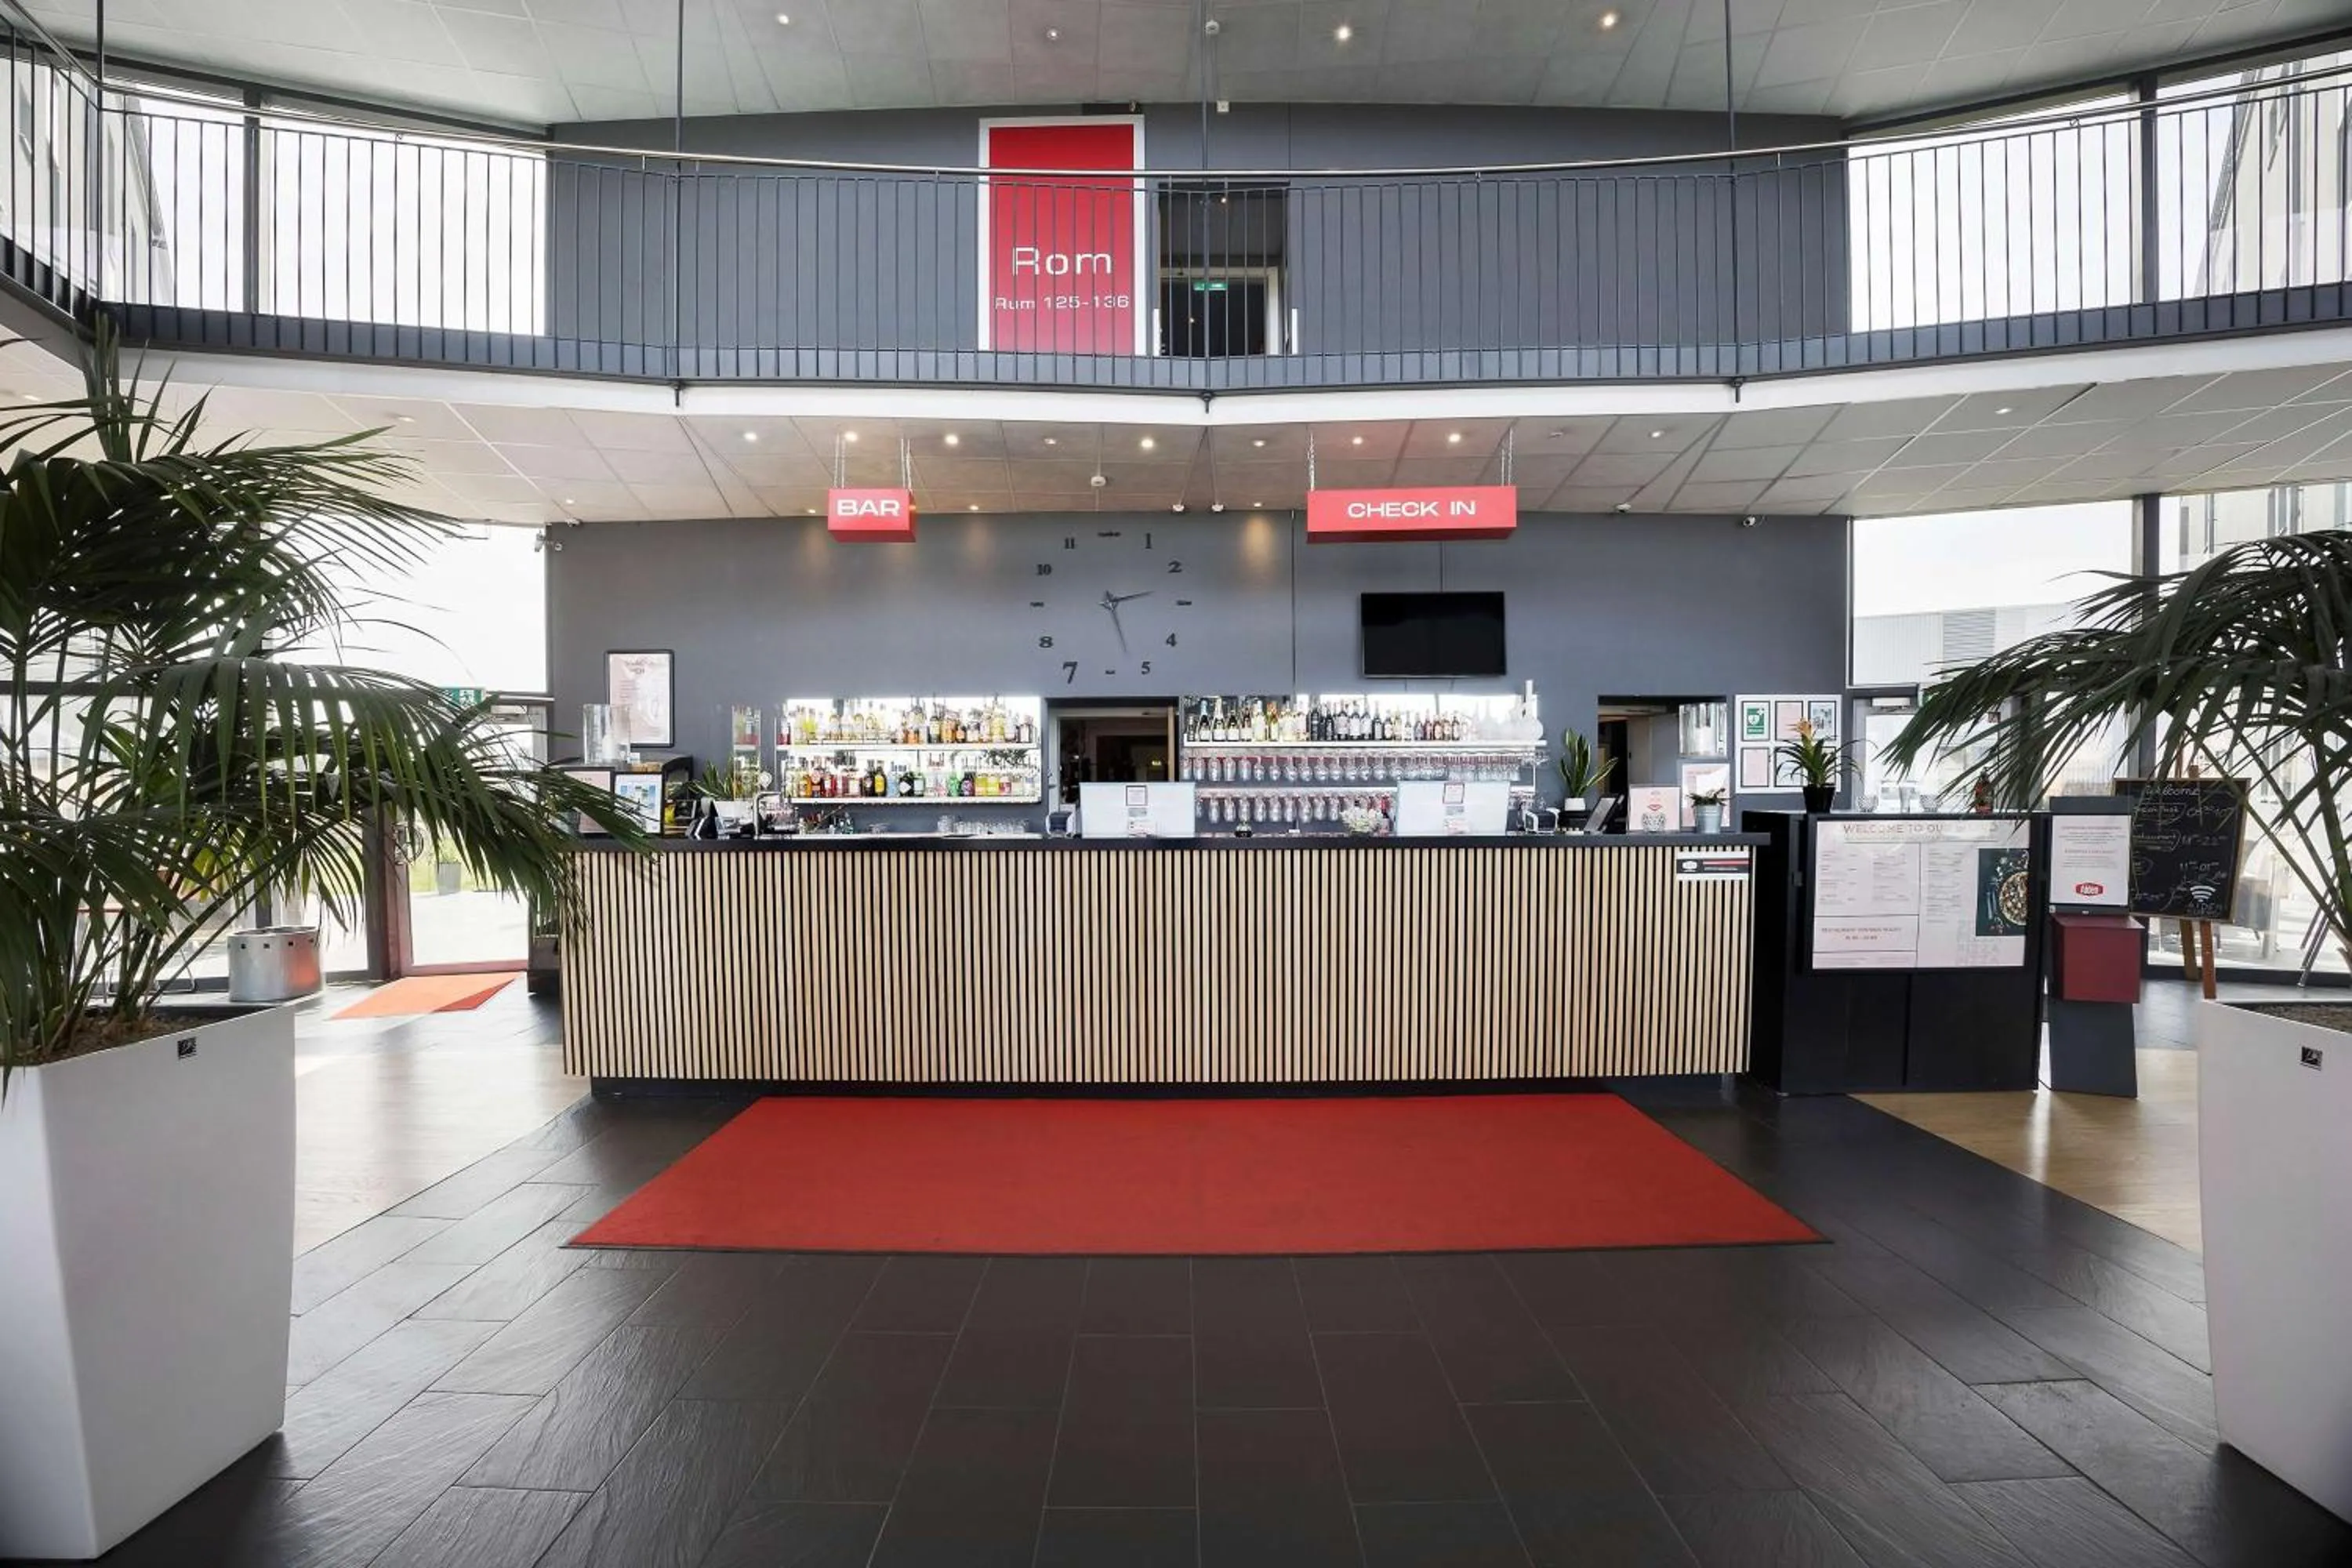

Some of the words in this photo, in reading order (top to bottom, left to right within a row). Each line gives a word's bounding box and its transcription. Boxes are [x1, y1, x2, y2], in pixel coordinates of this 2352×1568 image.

[1012, 247, 1112, 276] Rom
[995, 297, 1036, 310] Rum
[1044, 295, 1130, 310] 125-136
[837, 499, 901, 517] BAR
[1348, 501, 1441, 518] CHECK
[1450, 500, 1476, 515] IN
[1064, 538, 1076, 550] 11
[1145, 532, 1152, 550] 1
[1036, 564, 1052, 575] 10
[1167, 560, 1183, 574] 2
[1039, 636, 1053, 648] 8
[1166, 633, 1177, 647] 4
[1062, 661, 1078, 684] 7
[1141, 661, 1151, 675] 5
[1843, 823, 1904, 833] WELCOME
